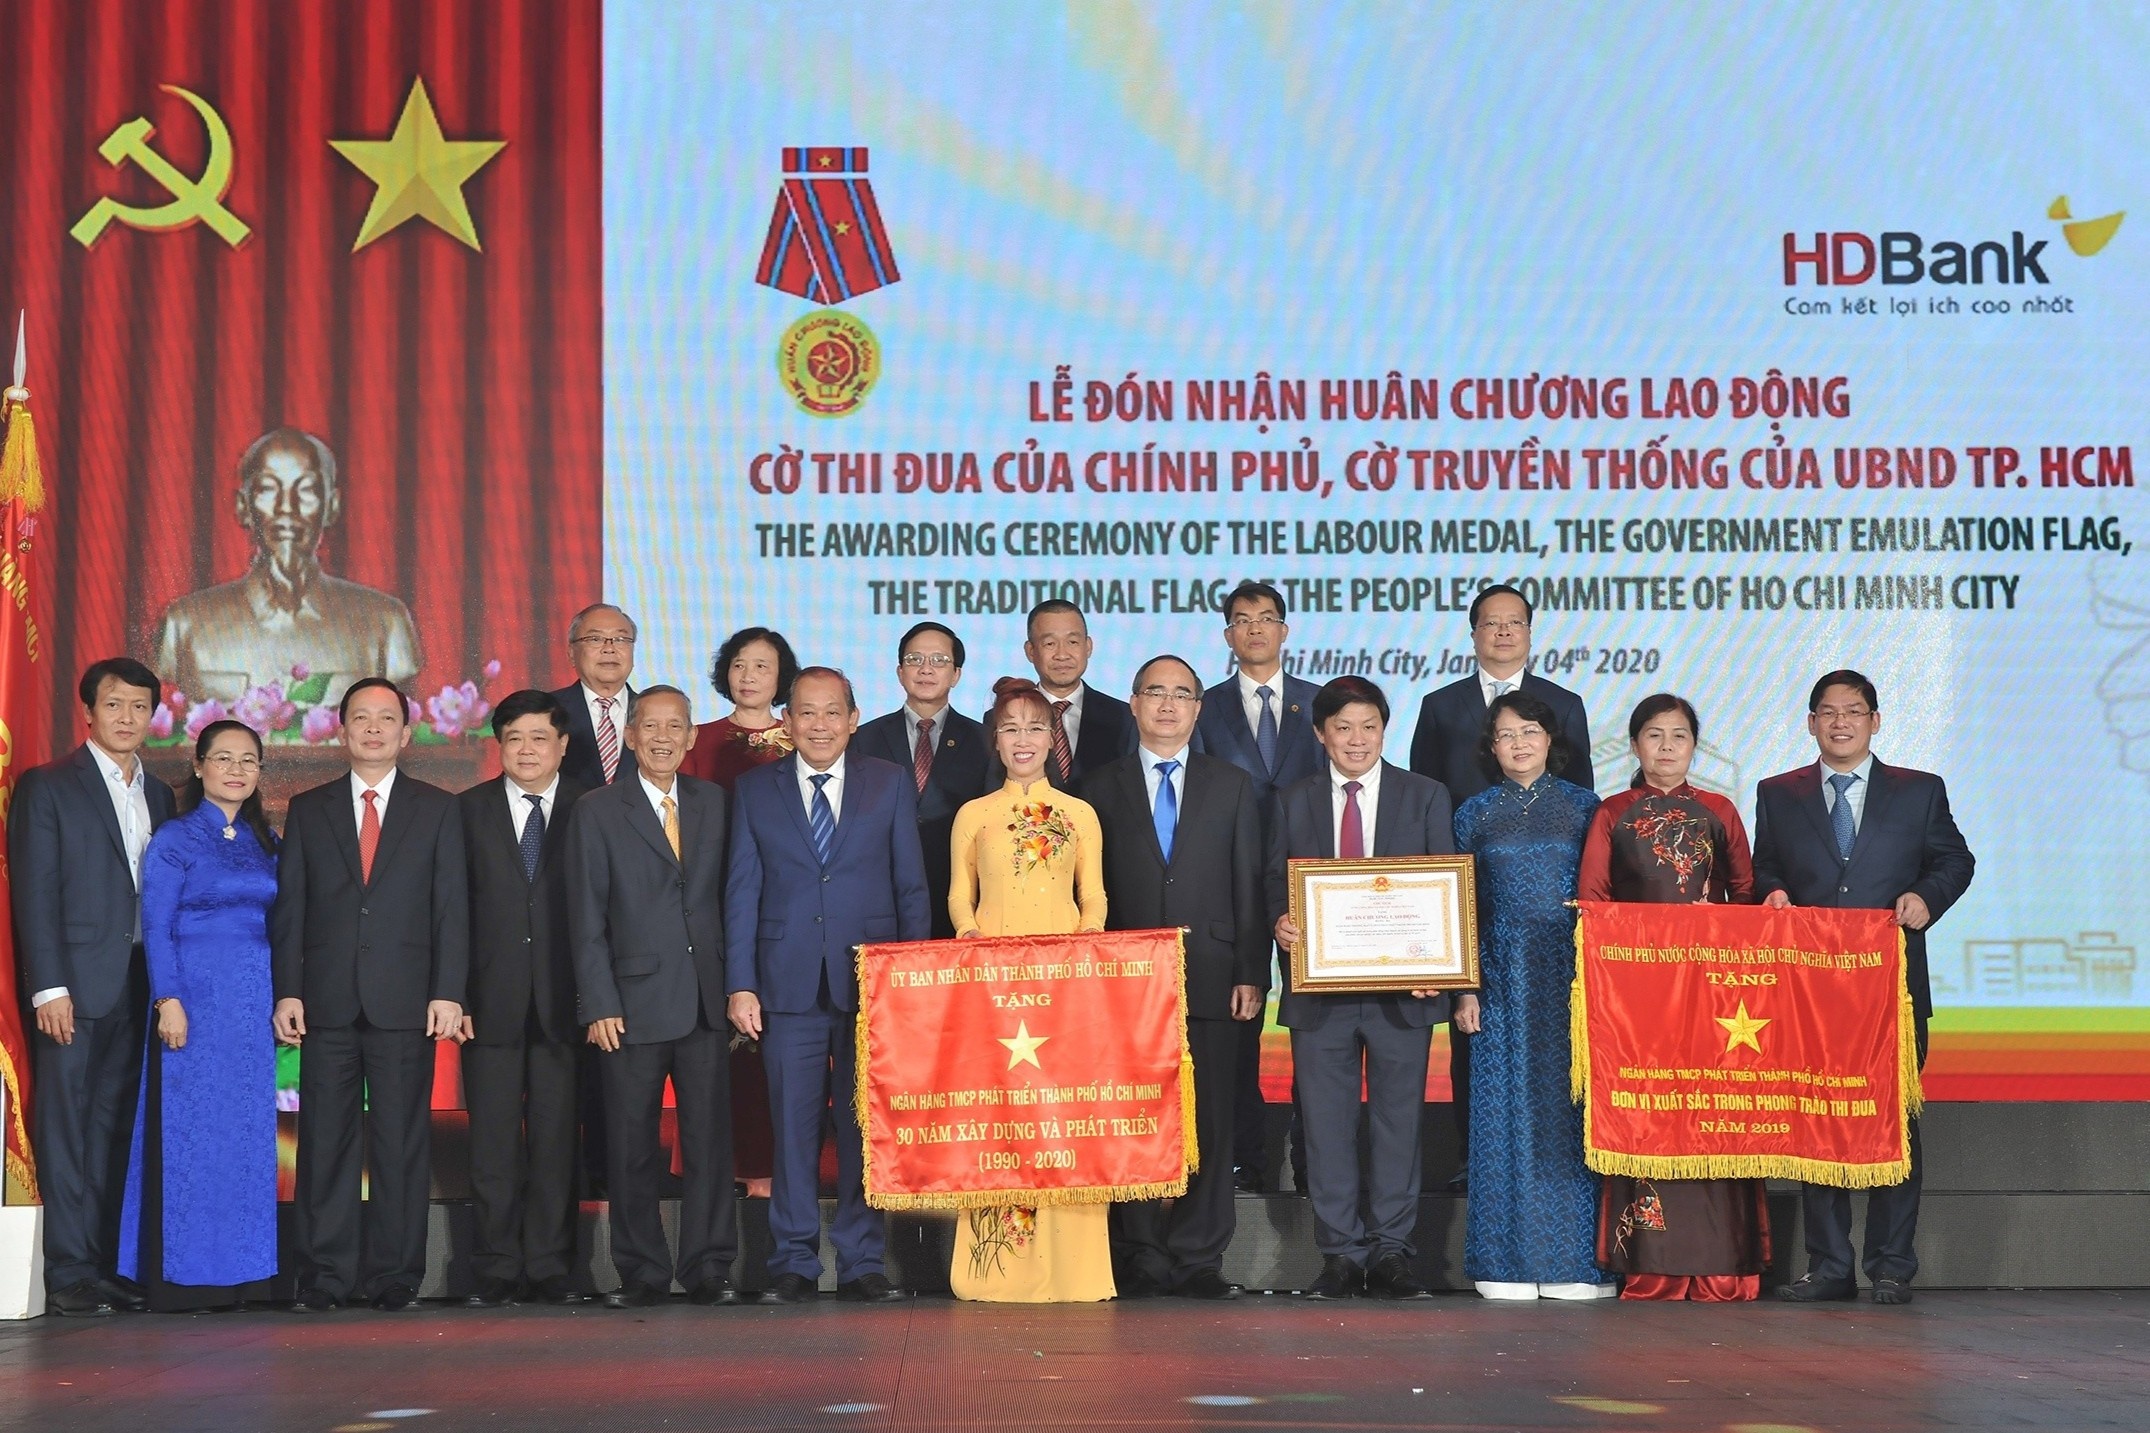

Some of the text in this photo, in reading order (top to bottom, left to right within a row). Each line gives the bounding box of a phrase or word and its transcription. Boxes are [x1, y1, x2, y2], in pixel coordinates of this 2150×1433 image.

[1784, 231, 2050, 285] HDBank
[1029, 365, 1850, 433] LỄ ĐÓN NHẬN HUÂN CHƯƠNG LAO ĐỘNG
[749, 434, 2134, 498] CỜ THI ĐUA CỦA CHÍNH PHỦ, CỜ TRUYỀN THỐNG CỦA UBND TP. HCM
[755, 517, 2132, 559] THE AWARDING CEREMONY OF THE LABOUR MEDAL, THE GOVERNMENT EMULATION FLAG,
[868, 580, 928, 614] THE
[1152, 578, 1227, 612] FLAG
[1283, 577, 1342, 612] THE
[1693, 576, 1731, 610] OF
[1740, 576, 1786, 610] HO
[1793, 576, 1845, 610] CHI
[1855, 576, 1943, 610] MINH
[1951, 575, 2019, 610] CITY
[1281, 650, 1305, 674] hi
[1308, 649, 1372, 675] Minh
[1379, 649, 1430, 681] City,
[1594, 649, 1660, 674] 2020
[890, 953, 1153, 988] ỦY BAN NHÂN DÂN THÀNH PHỐ HỒ CHÍ MINH
[1600, 942, 1633, 961] CHÍNH
[1635, 942, 1656, 963] PHỦ
[1658, 944, 1686, 963] NƯỚC
[1689, 943, 1716, 965] CỘNG
[1719, 945, 1740, 963] HÒA
[1757, 945, 1776, 966] HỘI
[1778, 944, 1798, 964] CHỦ
[1834, 949, 1856, 972] VIỆT
[1859, 952, 1882, 968] NAM
[1706, 972, 1778, 988] TẶNG
[992, 992, 1052, 1010] TẶNG
[1675, 1069, 1701, 1080] TMCP
[1704, 1066, 1729, 1081] PHÁT
[1843, 1076, 1867, 1088] MINH
[890, 1091, 916, 1111] NGÂN
[920, 1090, 945, 1110] HÀNG
[948, 1090, 976, 1107] TMCP
[979, 1085, 1004, 1105] PHÁT
[1006, 1081, 1037, 1105] TRIỂN
[1040, 1084, 1074, 1104] THÀNH
[1077, 1080, 1098, 1102] PHỐ
[1116, 1082, 1133, 1101] CHÍ
[1136, 1084, 1161, 1100] MINH
[1611, 1089, 1877, 1117] ĐƠN VỊ XUẤT SẮC TRONG PHONG TRÀO THI ĐUA
[896, 1108, 1158, 1145] 30 NĂM XÂY DỰNG VÀ PHÁT TRIỂN
[1699, 1119, 1790, 1134] NĂM 2019
[978, 1151, 1020, 1173] (1990
[1034, 1149, 1076, 1170] 2020)
